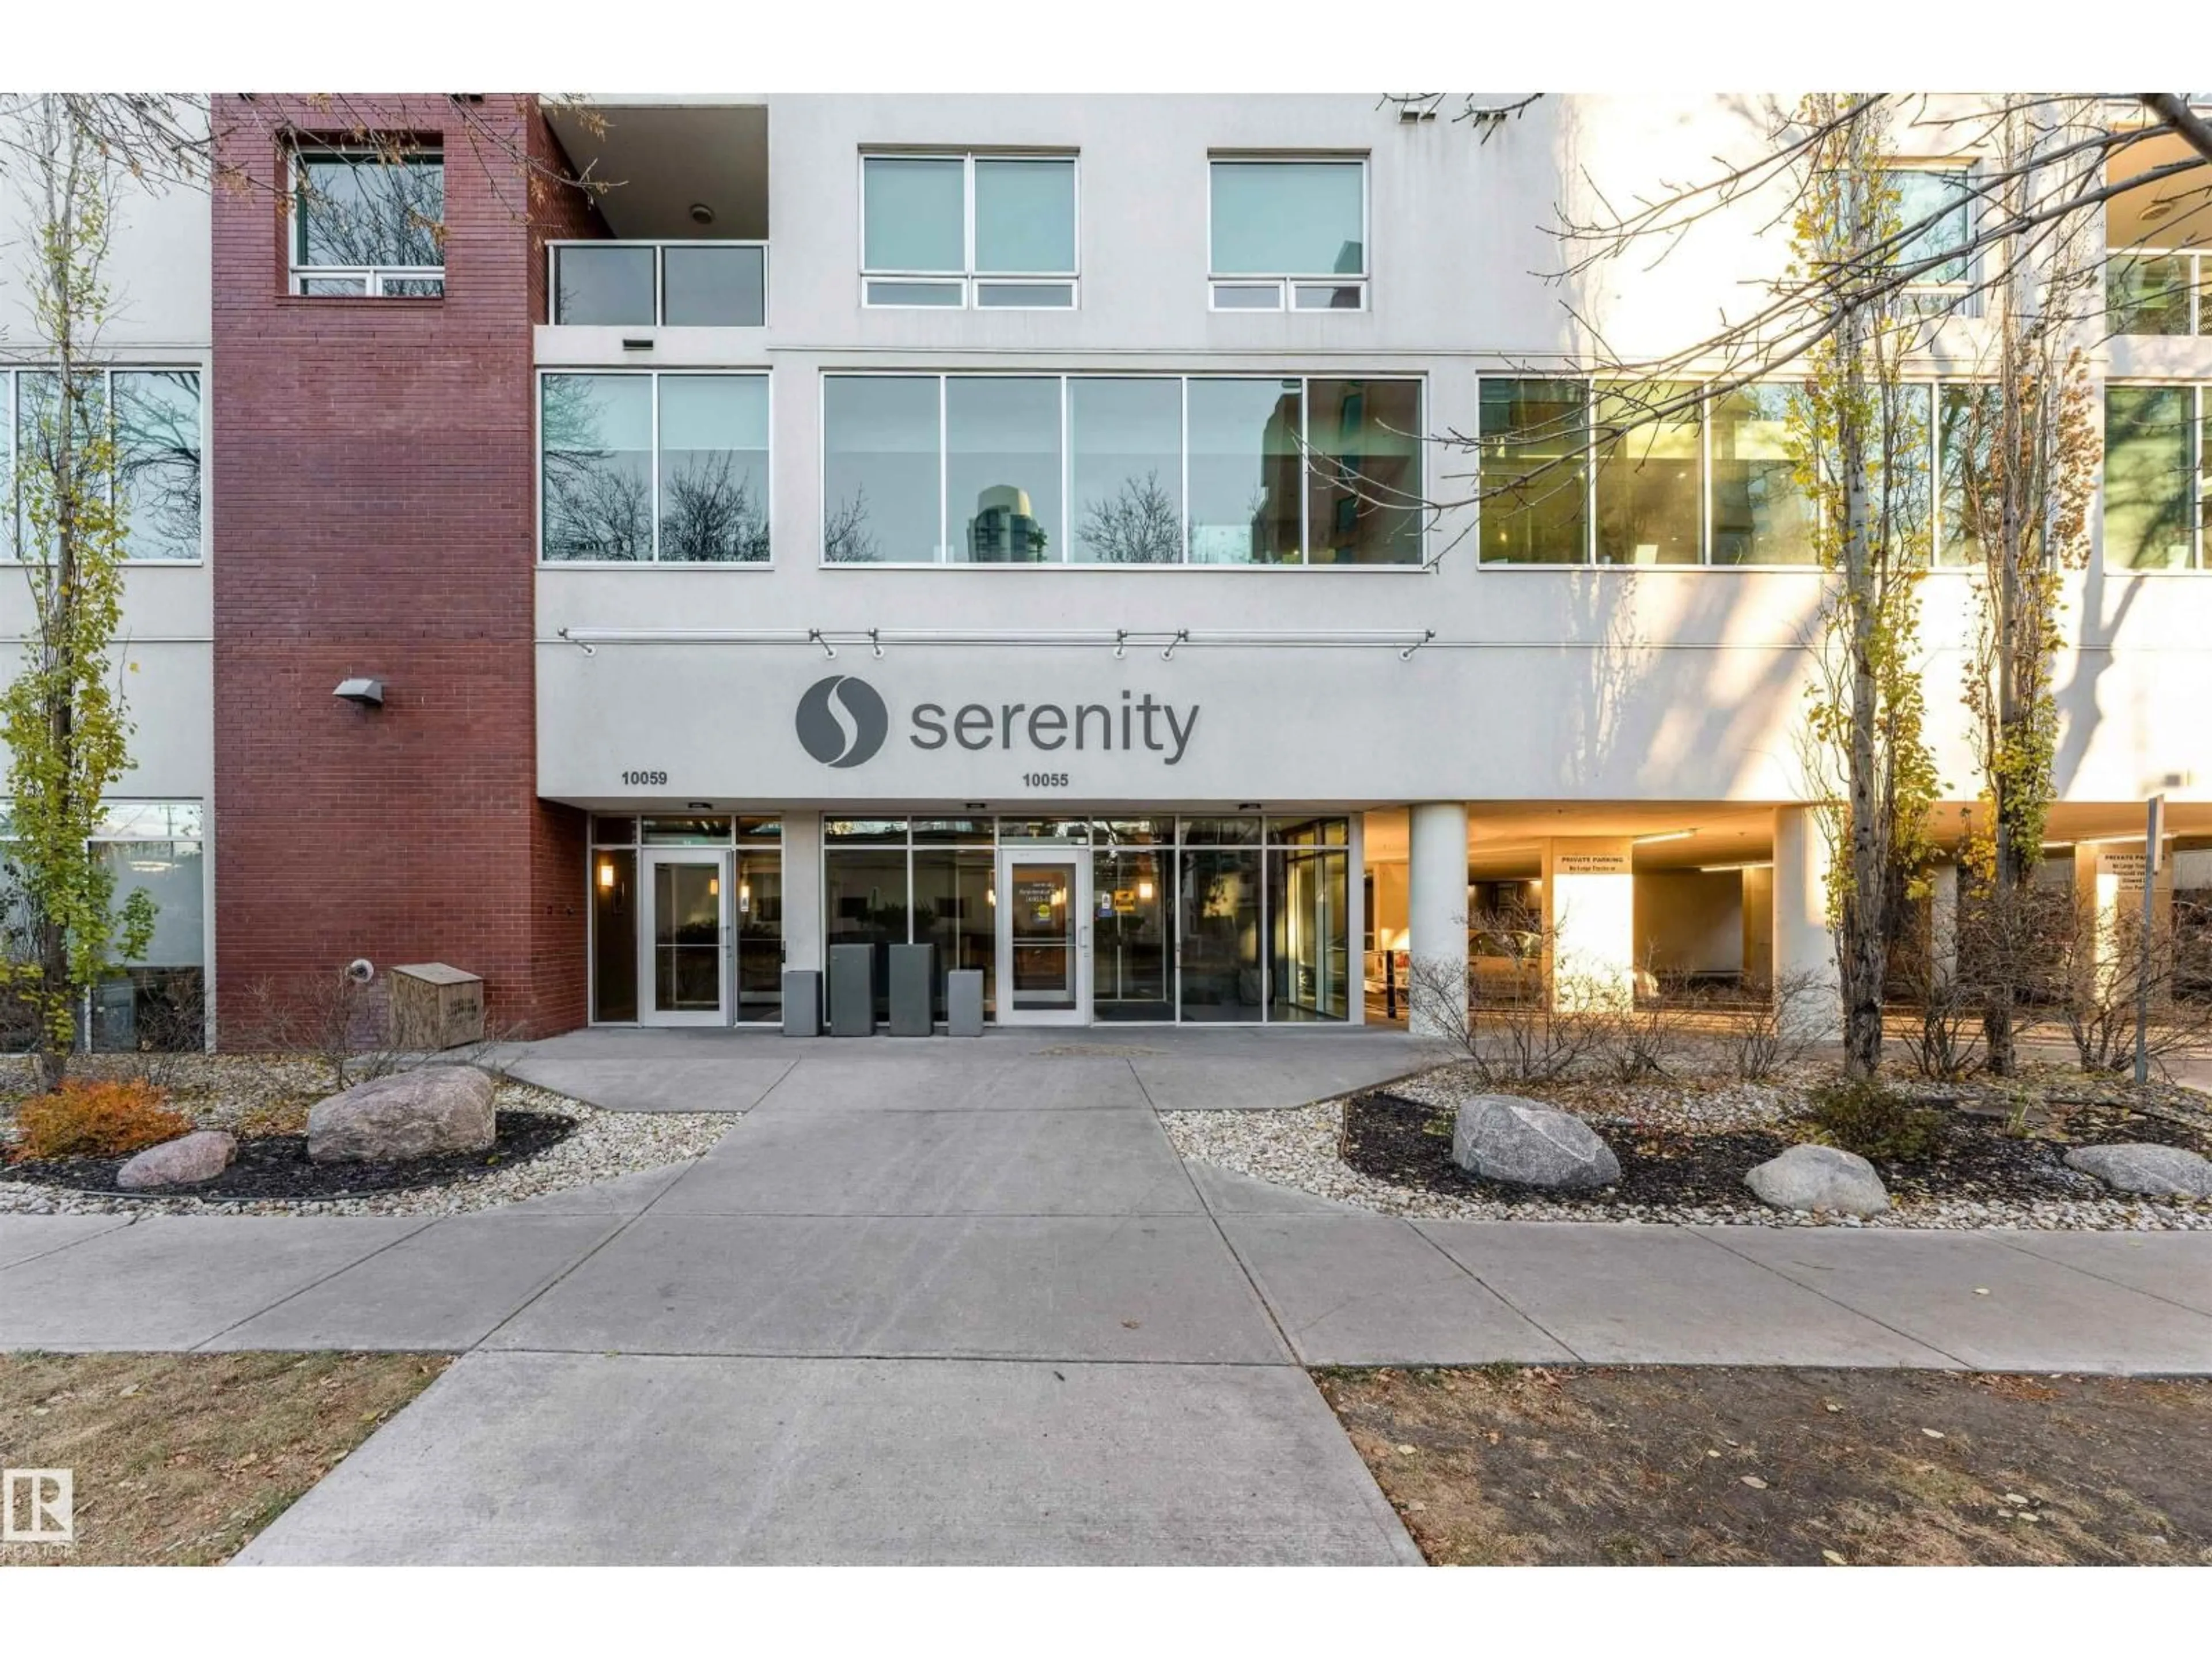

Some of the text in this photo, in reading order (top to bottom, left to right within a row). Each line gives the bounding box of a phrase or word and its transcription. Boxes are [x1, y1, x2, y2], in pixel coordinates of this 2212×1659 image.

[910, 690, 1200, 766] serenity
[622, 771, 668, 786] 10059
[1022, 772, 1069, 787] 10055
